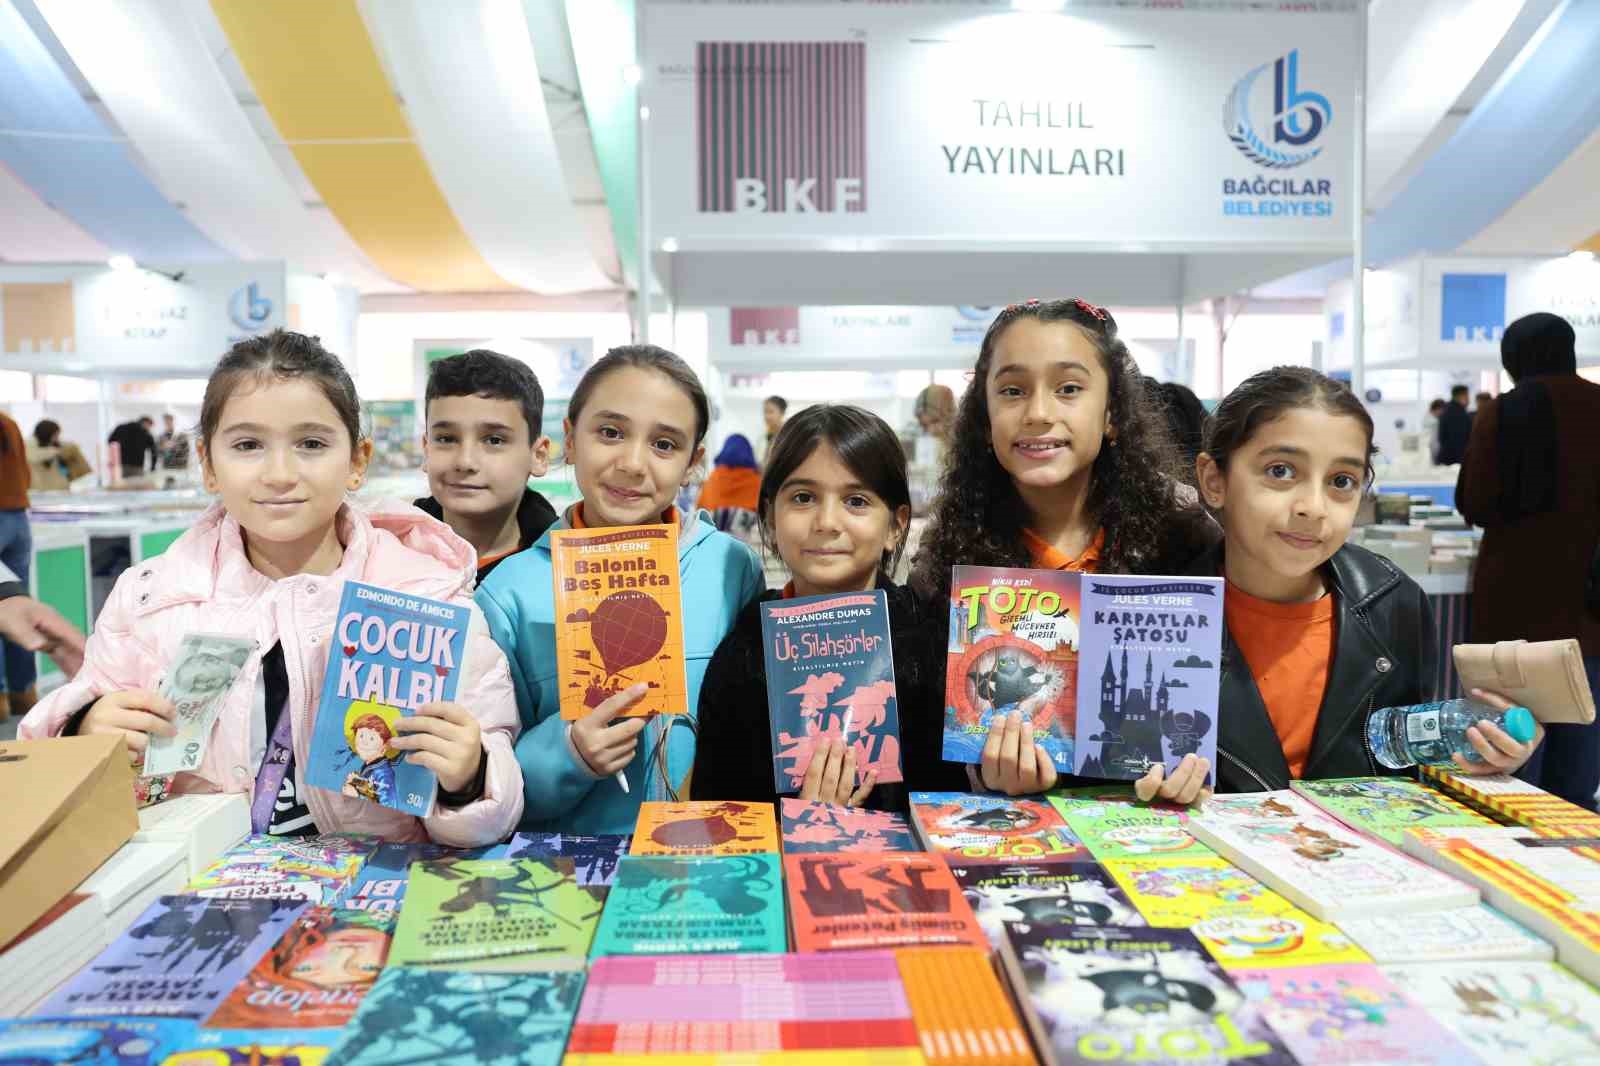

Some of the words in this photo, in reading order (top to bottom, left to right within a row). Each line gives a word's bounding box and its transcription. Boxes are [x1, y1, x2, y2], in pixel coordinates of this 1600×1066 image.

[941, 144, 1124, 176] YAYINLARI
[736, 177, 862, 213] BKF
[1223, 174, 1332, 196] BAĞCILAR
[1223, 200, 1332, 217] BELEDİYESİ
[580, 543, 612, 553] JULES
[616, 541, 650, 551] VERNE
[574, 557, 657, 574] Balonla
[563, 577, 602, 596] Beş
[608, 573, 670, 589] Hafta
[355, 588, 405, 608] EDMONDO
[406, 599, 420, 612] DE
[420, 602, 456, 621] AMICIS
[960, 586, 1062, 631] TOTO
[1111, 593, 1149, 605] JULES
[1151, 596, 1193, 607] VERNE
[776, 611, 835, 625] ALEXANDRE
[837, 608, 872, 619] DUMAS
[1094, 610, 1209, 628] KARPATLAR
[775, 630, 800, 663] Üç
[800, 628, 883, 659] Silahşörler
[1113, 627, 1188, 645] ŞATOSU
[337, 657, 450, 710] KALBİ
[181, 742, 200, 767] 20
[961, 834, 1076, 858] TOTO
[1032, 874, 1079, 884] DERMOT
[1078, 1012, 1270, 1060] TOTO
